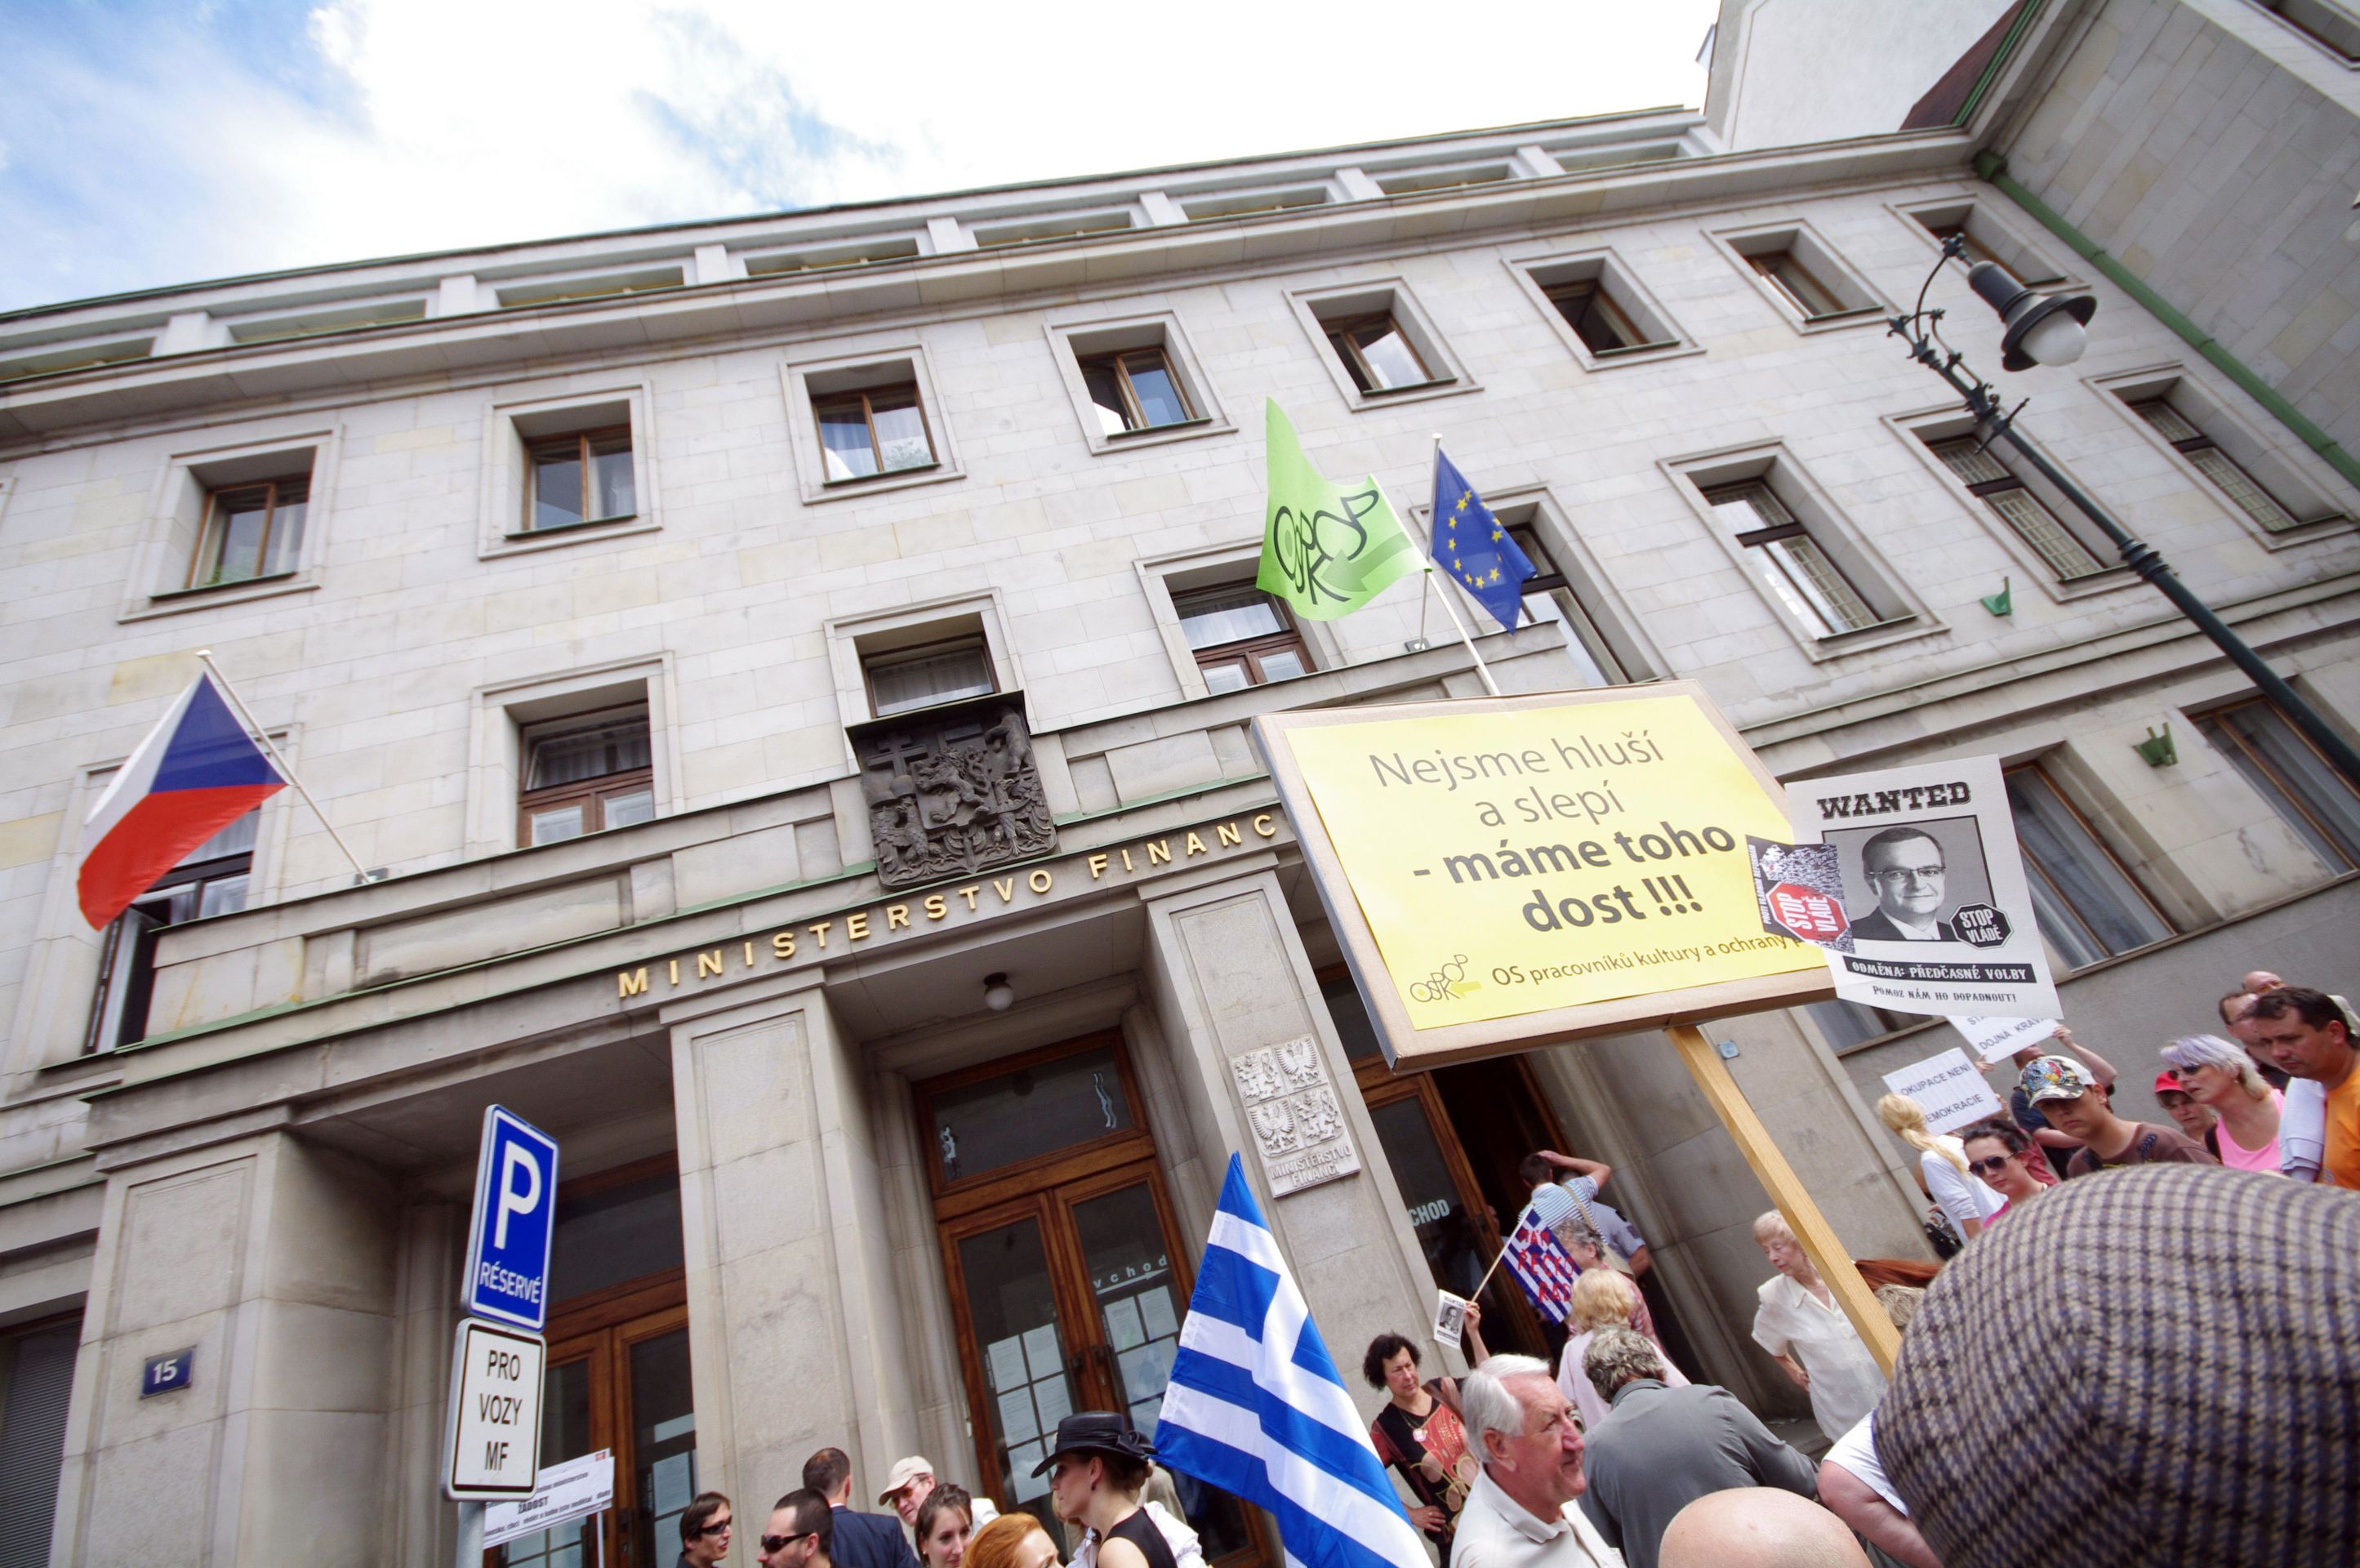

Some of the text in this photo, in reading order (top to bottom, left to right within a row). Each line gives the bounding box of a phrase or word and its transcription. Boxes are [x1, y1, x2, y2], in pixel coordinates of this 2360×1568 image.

[1369, 729, 1664, 791] Nejsme hluší
[1475, 779, 1626, 827] a slepí
[1816, 781, 1972, 820] WANTED
[1442, 839, 1612, 884] máme
[1613, 821, 1736, 863] toho
[617, 814, 1277, 999] MINISTERSTVO FINANC
[1521, 884, 1648, 933] dost
[1776, 892, 1813, 930] STOP
[1801, 895, 1839, 932] VLÁDĚ
[1958, 907, 1994, 929] STOP
[1965, 925, 2003, 943] VLÁDĚ
[1491, 965, 1525, 987] OS
[1529, 951, 1635, 986] pracovníků
[1632, 947, 1700, 967] kultury
[1703, 944, 1716, 957] a
[1717, 934, 1787, 954] ochrany
[1851, 960, 2028, 981] ODMĚNA: PŘEDČASNÉ VOLBY
[1935, 991, 1949, 1001] HO
[1900, 1072, 1948, 1096] OKUPACE
[1924, 1094, 1984, 1124] EMOKRACIE
[1269, 1145, 1352, 1180] MINISTERSTVO
[493, 1139, 541, 1251] P
[1408, 1198, 1450, 1227] CHOD
[479, 1260, 542, 1304] RÉSERVÉ
[1093, 1254, 1168, 1289] vchod
[152, 1358, 179, 1385] 15
[487, 1349, 521, 1382] PRO
[479, 1392, 523, 1426] VOZY
[484, 1441, 509, 1471] MF
